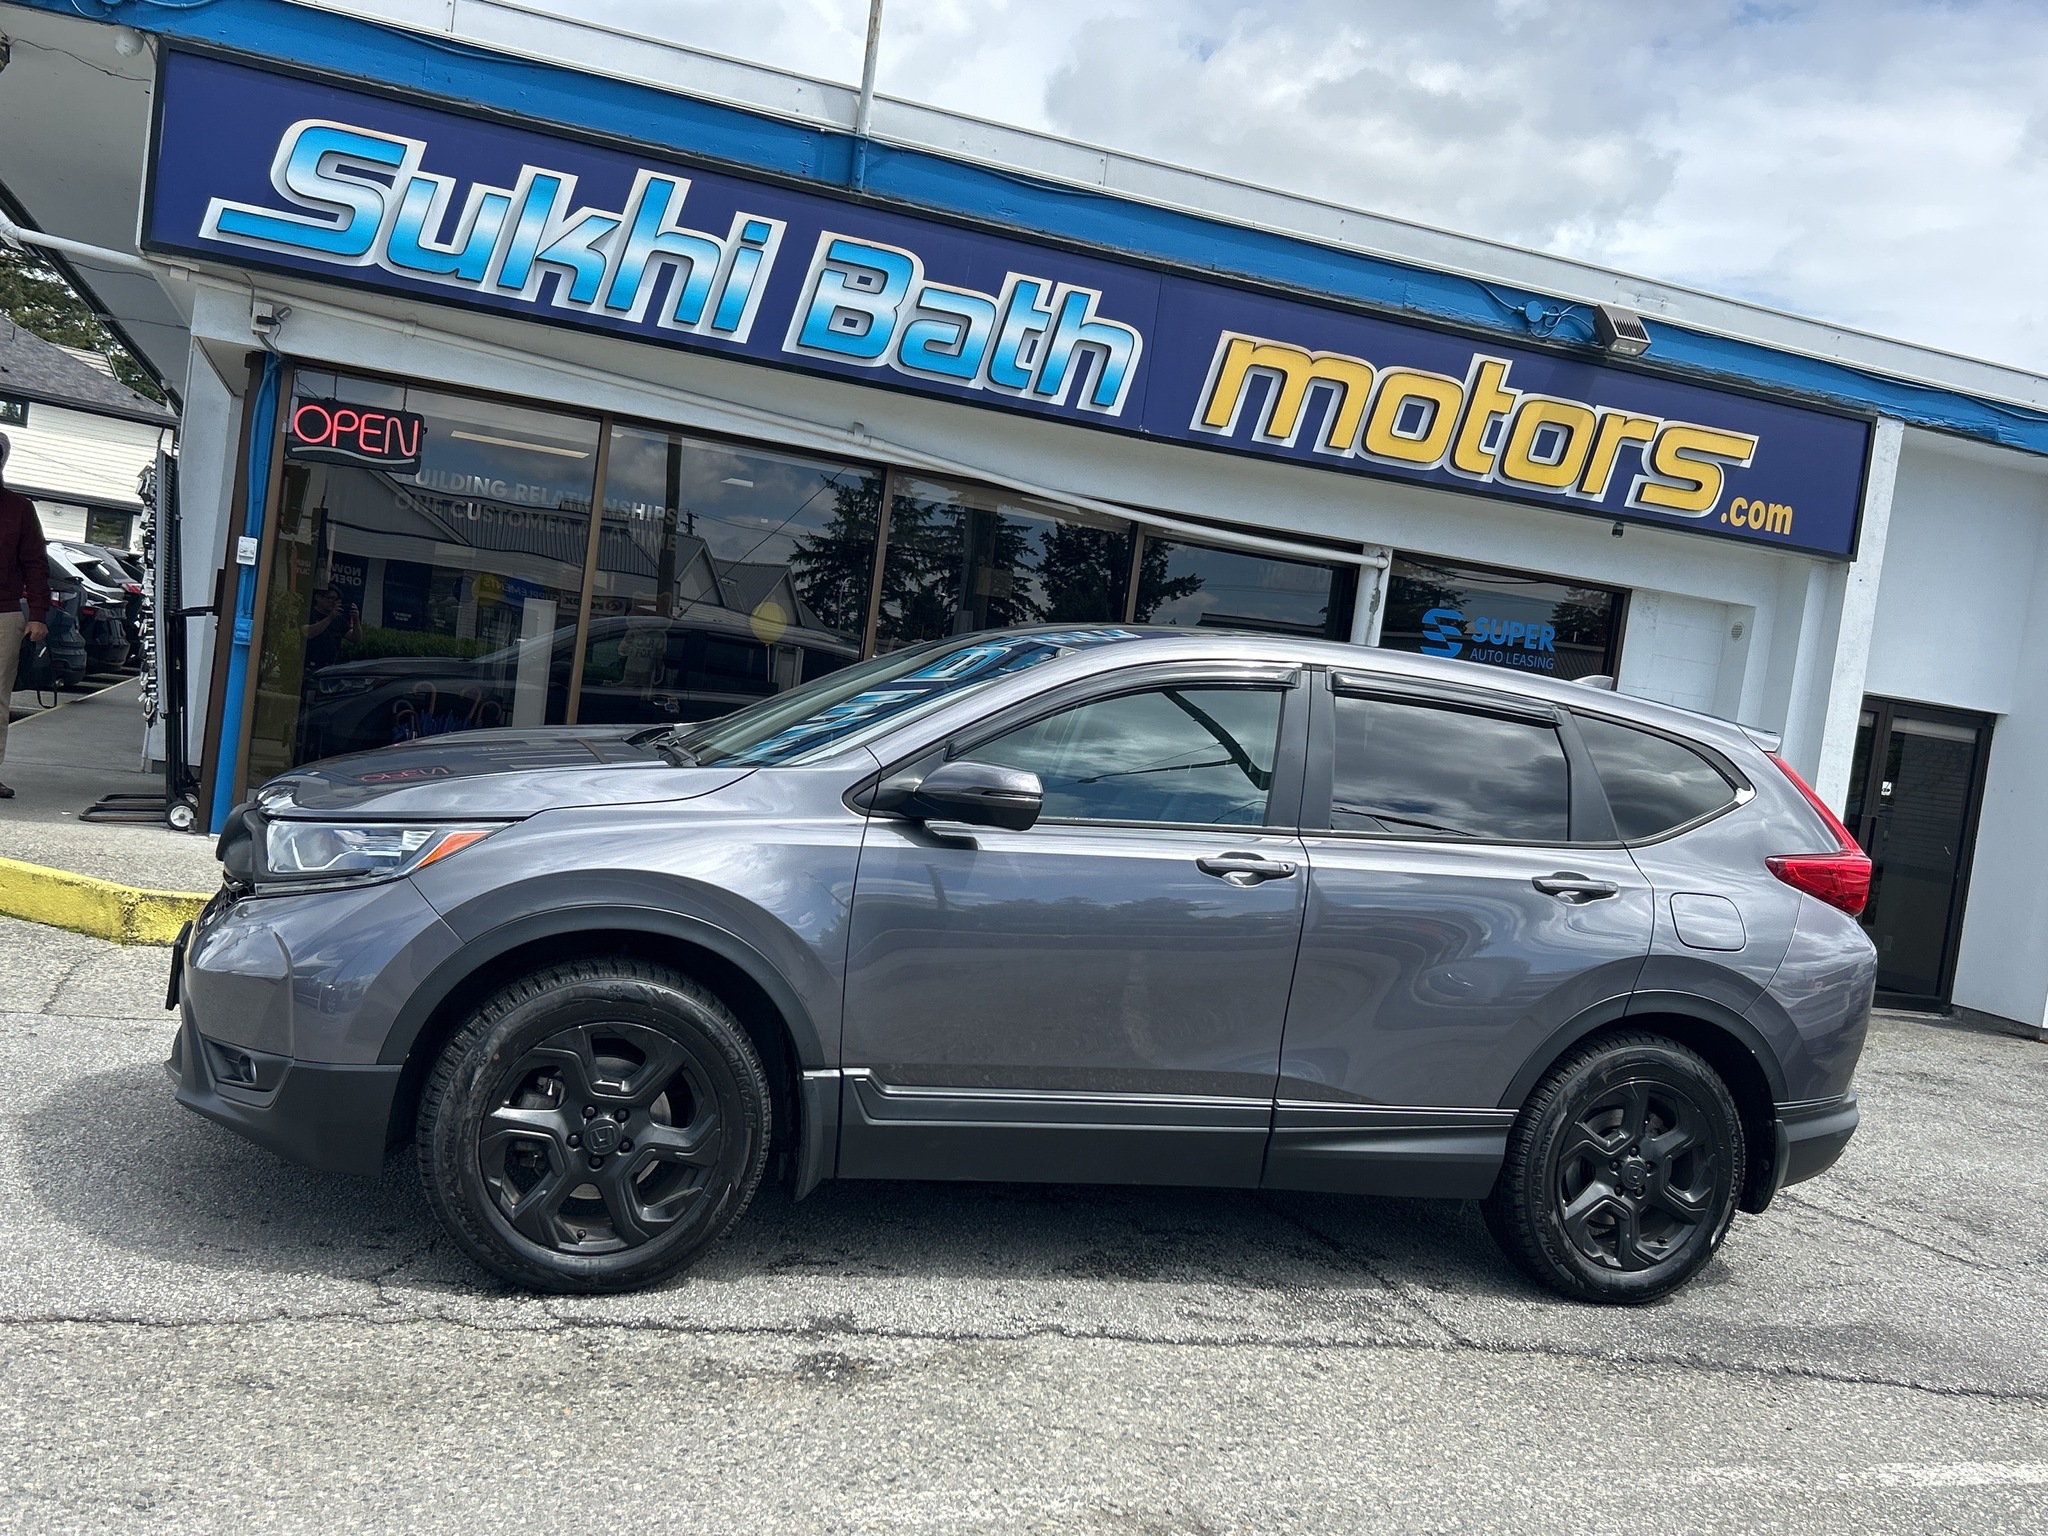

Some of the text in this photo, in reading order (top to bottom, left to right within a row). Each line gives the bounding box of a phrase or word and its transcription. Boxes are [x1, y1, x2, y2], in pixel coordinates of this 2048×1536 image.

[199, 119, 1793, 535] Sukhi Bath motors .com
[293, 404, 420, 457] OPEN
[451, 500, 570, 536] CUSTOMER
[1471, 616, 1556, 653] SUPER
[1470, 647, 1555, 670] AUTO LEASING
